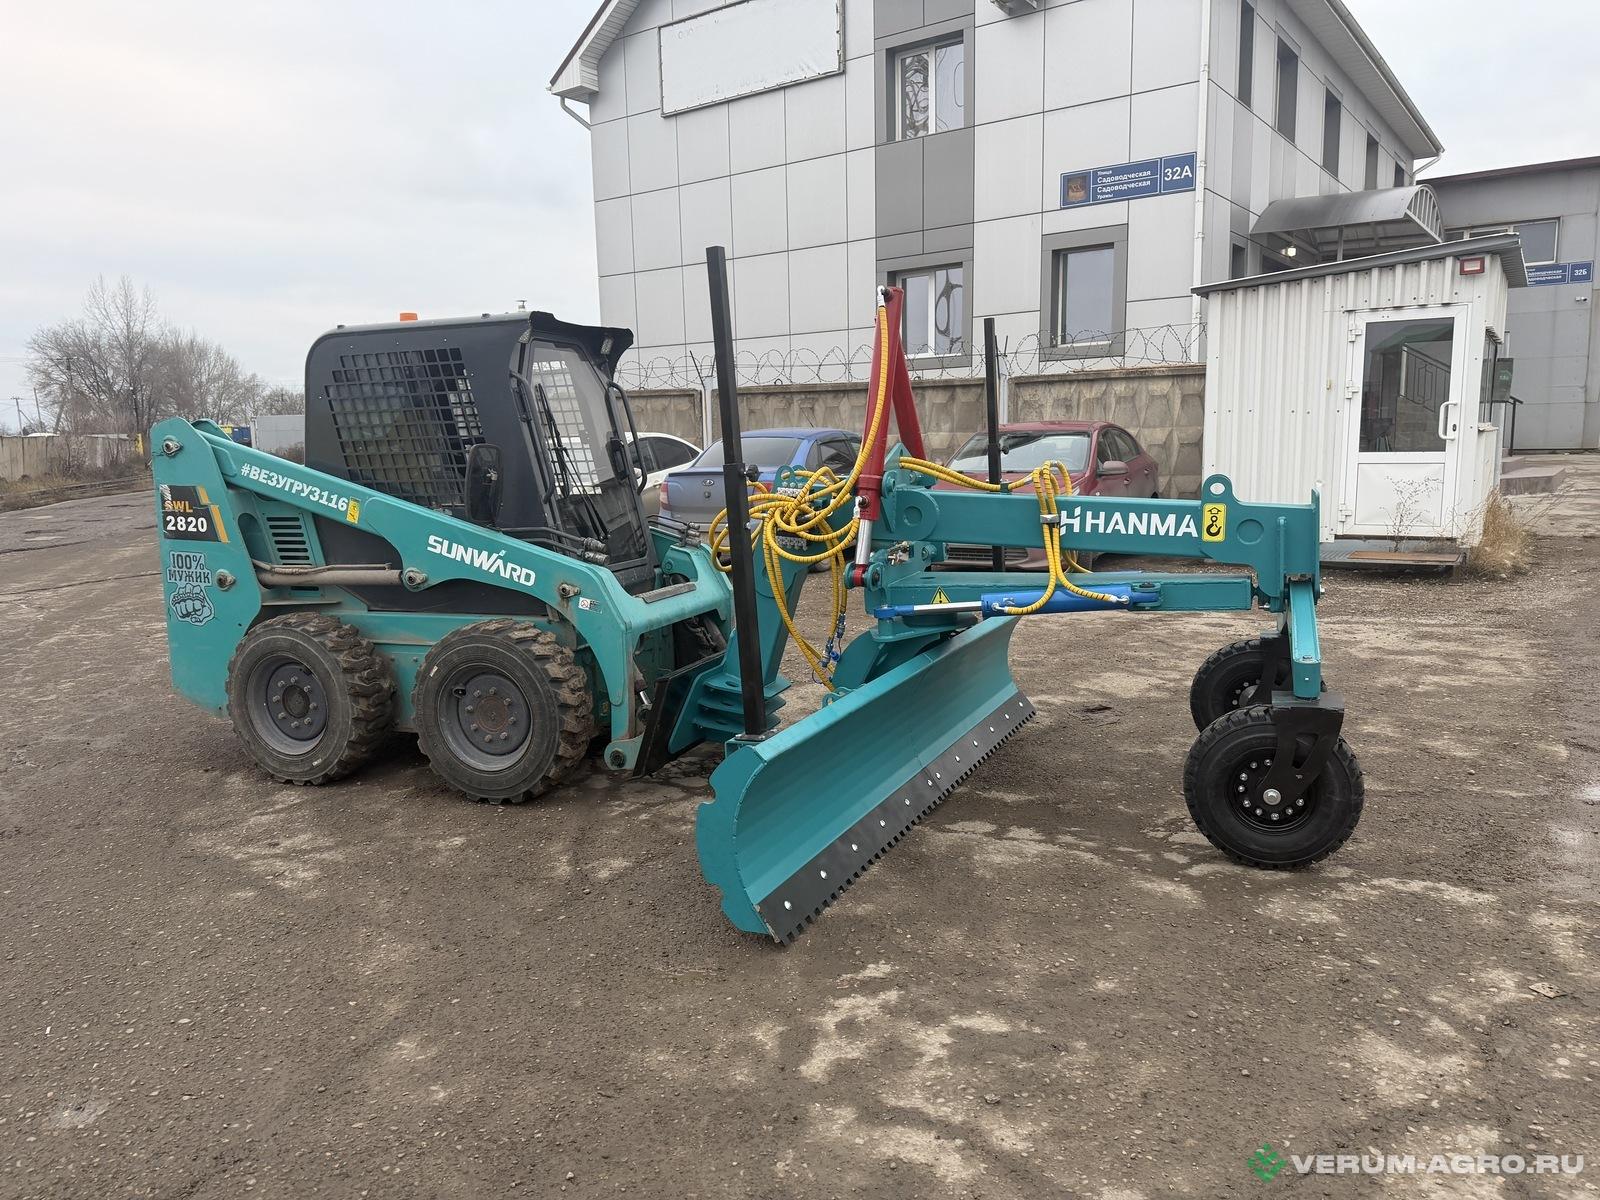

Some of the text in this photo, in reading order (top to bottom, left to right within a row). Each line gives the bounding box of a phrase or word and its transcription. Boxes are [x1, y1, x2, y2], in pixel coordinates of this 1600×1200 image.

[1097, 170, 1151, 184] Садоводческая
[1164, 165, 1192, 181] 32А
[1097, 181, 1151, 193] Садоводческая
[164, 500, 193, 513] SWL
[166, 515, 208, 533] 2820
[1085, 511, 1198, 538] HANMA
[171, 553, 205, 571] 100%
[427, 534, 536, 587] SUNWARD
[168, 569, 211, 584] МУЖИК
